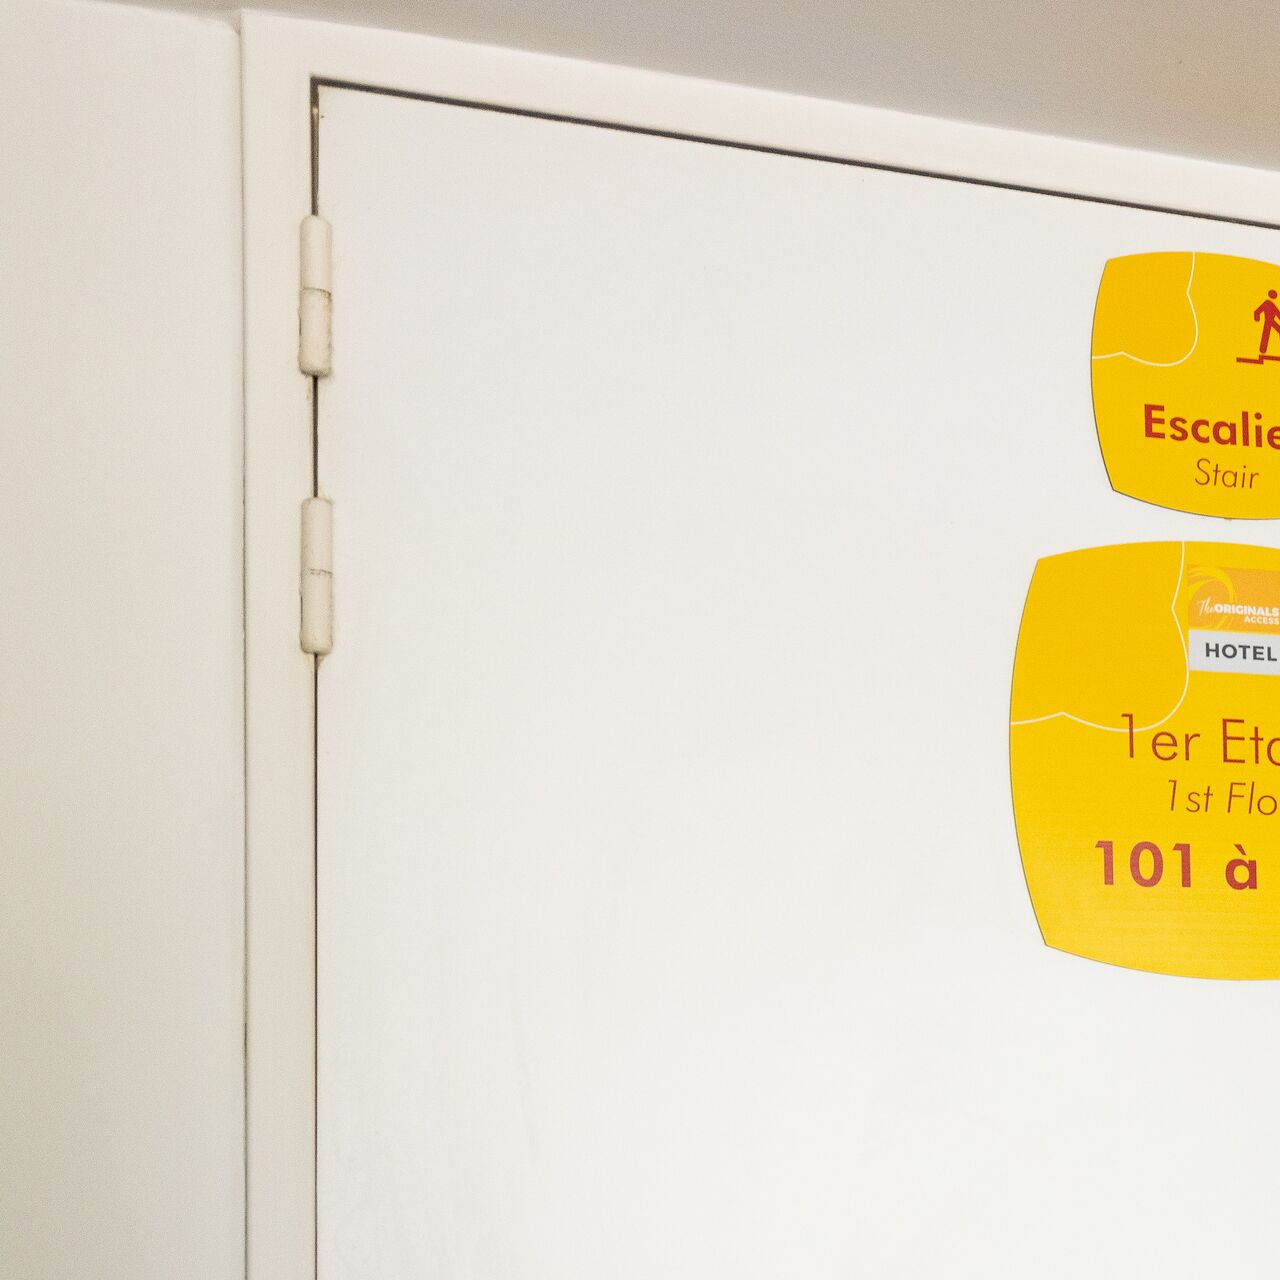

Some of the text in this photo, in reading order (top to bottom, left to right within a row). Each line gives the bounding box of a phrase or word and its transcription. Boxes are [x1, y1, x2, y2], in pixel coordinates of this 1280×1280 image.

[1194, 457, 1260, 490] Stair
[1214, 603, 1280, 617] ORIGINALS
[1243, 613, 1280, 626] ACCESS
[1205, 642, 1278, 661] HOTEL
[1121, 712, 1201, 763] 1er
[1166, 779, 1213, 814] 1st
[1096, 840, 1193, 888] 101
[1226, 845, 1258, 891] à
